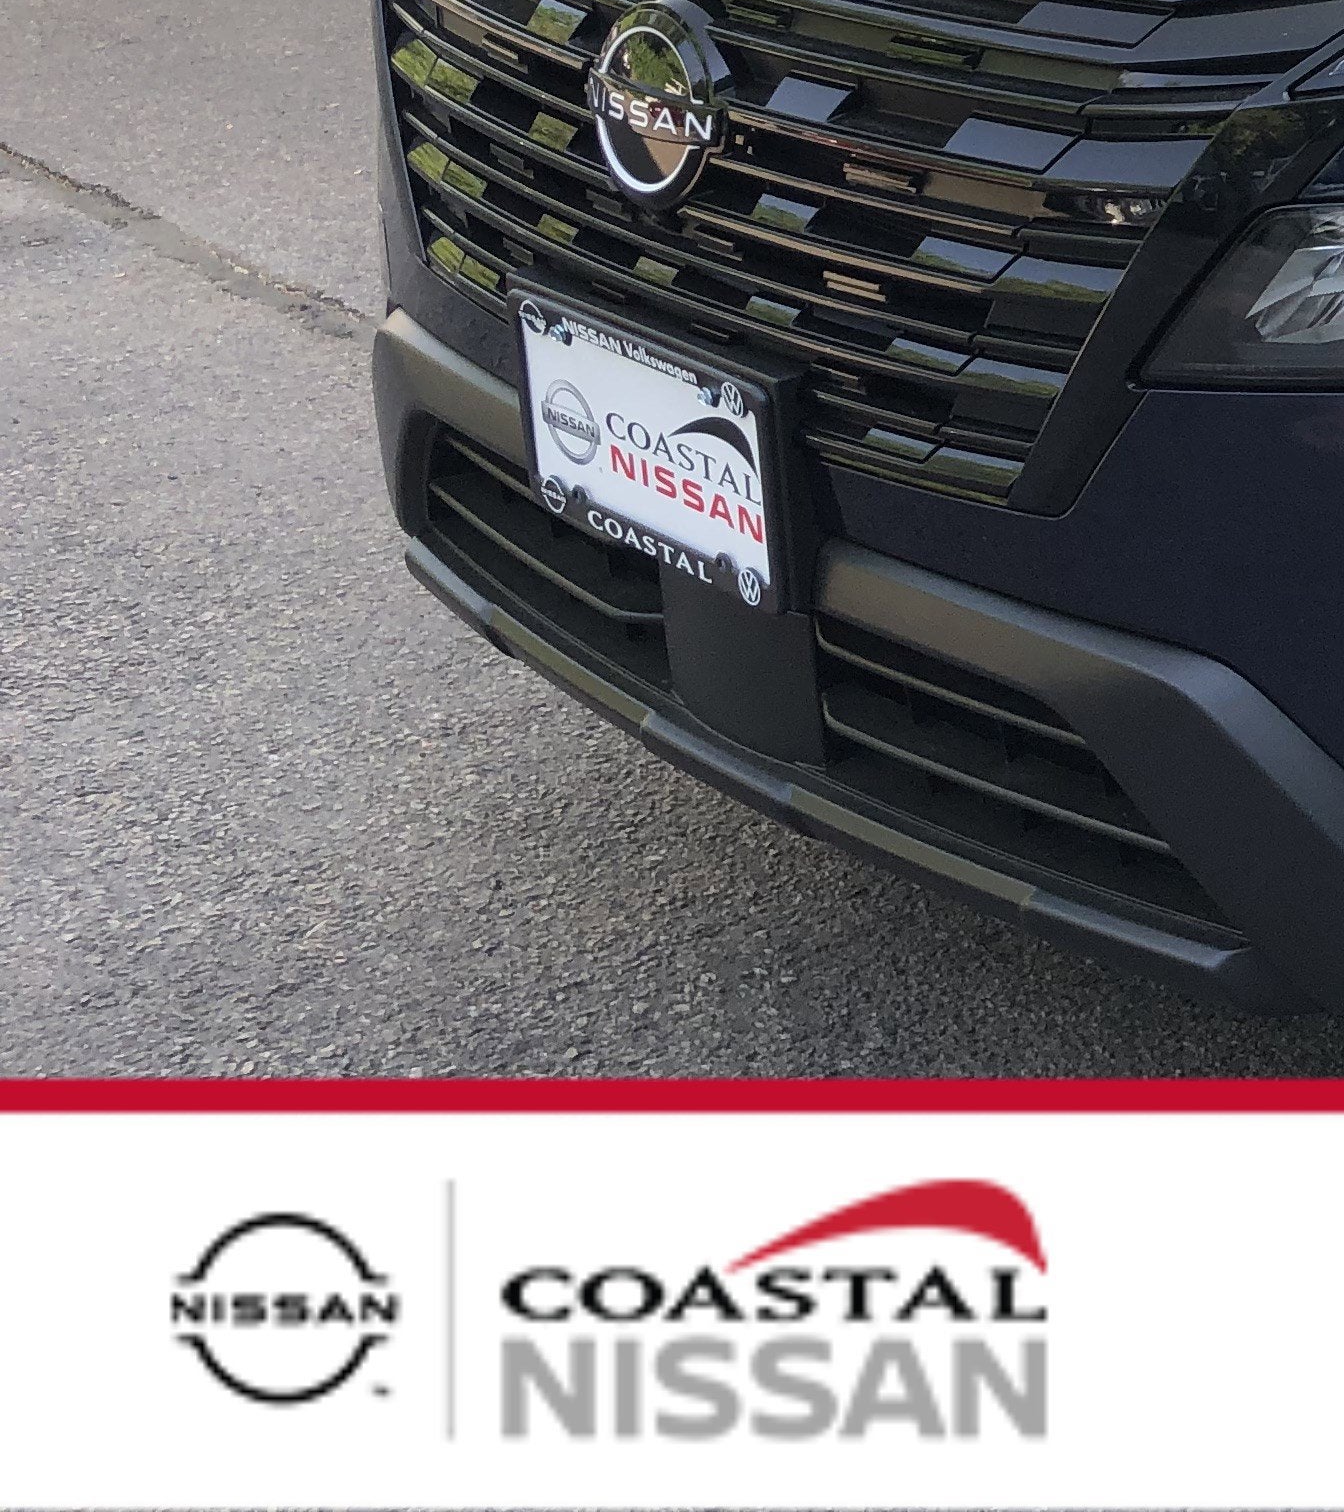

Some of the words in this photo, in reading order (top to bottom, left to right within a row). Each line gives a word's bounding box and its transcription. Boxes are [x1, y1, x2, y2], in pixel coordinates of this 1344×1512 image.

[589, 76, 713, 141] NISSAN
[561, 316, 623, 357] NISSAN
[623, 339, 698, 385] Volkswagen
[546, 406, 596, 439] NISSAN
[605, 412, 763, 506] COASTAL
[610, 443, 765, 544] NISSAN
[587, 509, 713, 584] COASTAL
